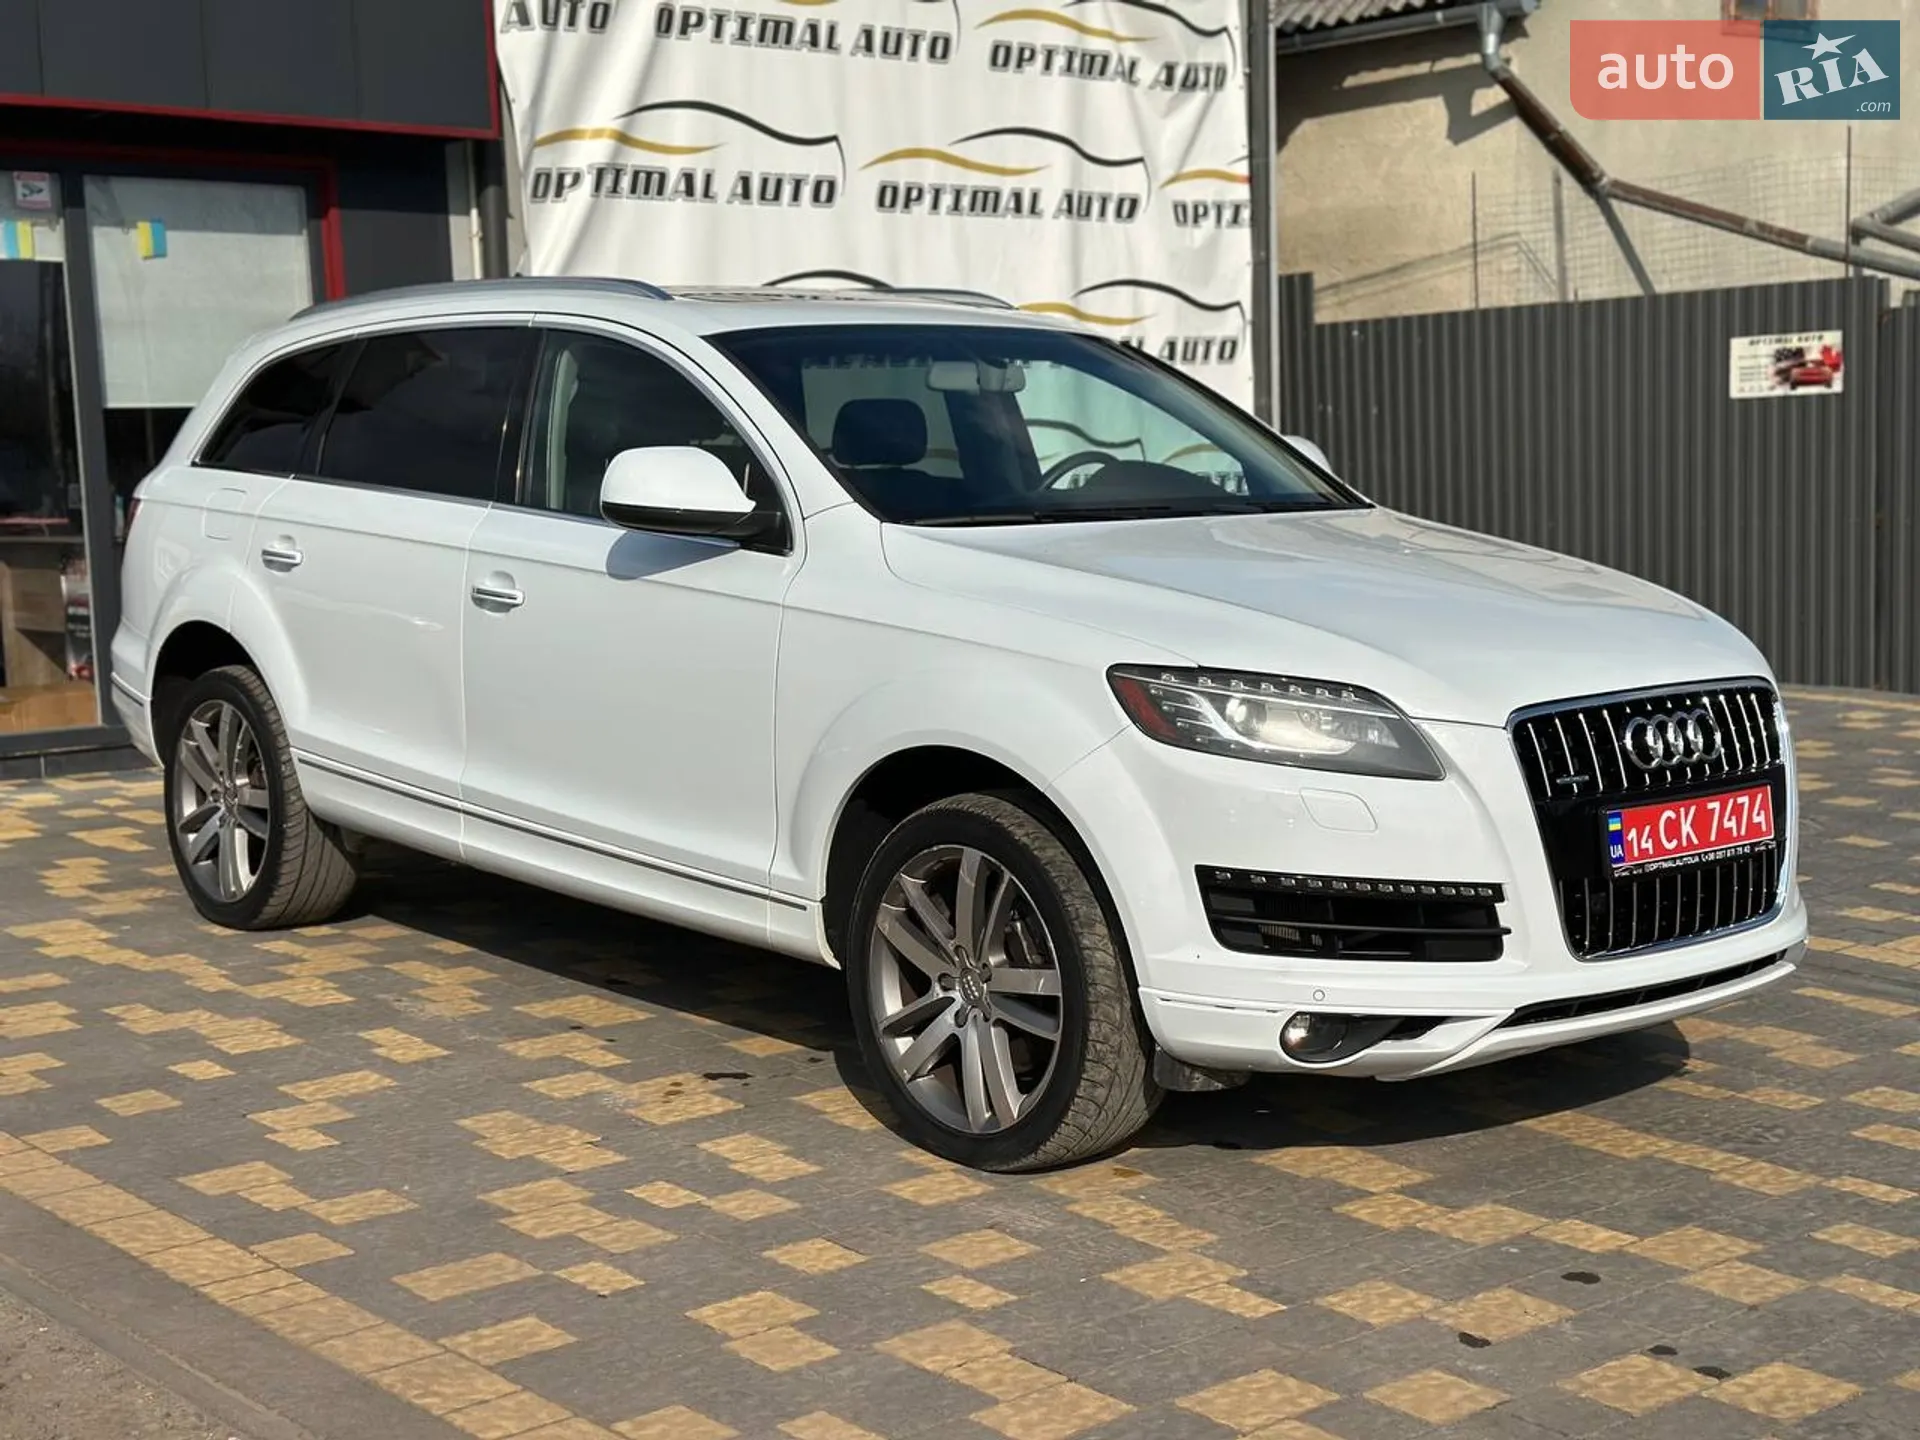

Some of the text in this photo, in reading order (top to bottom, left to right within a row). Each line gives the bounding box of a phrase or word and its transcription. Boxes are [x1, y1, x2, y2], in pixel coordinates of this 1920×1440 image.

[500, 0, 612, 34] AUTO
[655, 3, 952, 65] OPTIMAL AUTO
[989, 39, 1228, 93] OPTIMAL AUTO
[529, 162, 838, 209] OPTIMAL AUTO
[876, 180, 1142, 224] OPTIMAL AUTO
[1159, 336, 1240, 365] AUTO
[1627, 792, 1767, 857] 14 CK 7474
[1610, 845, 1624, 859] UA
